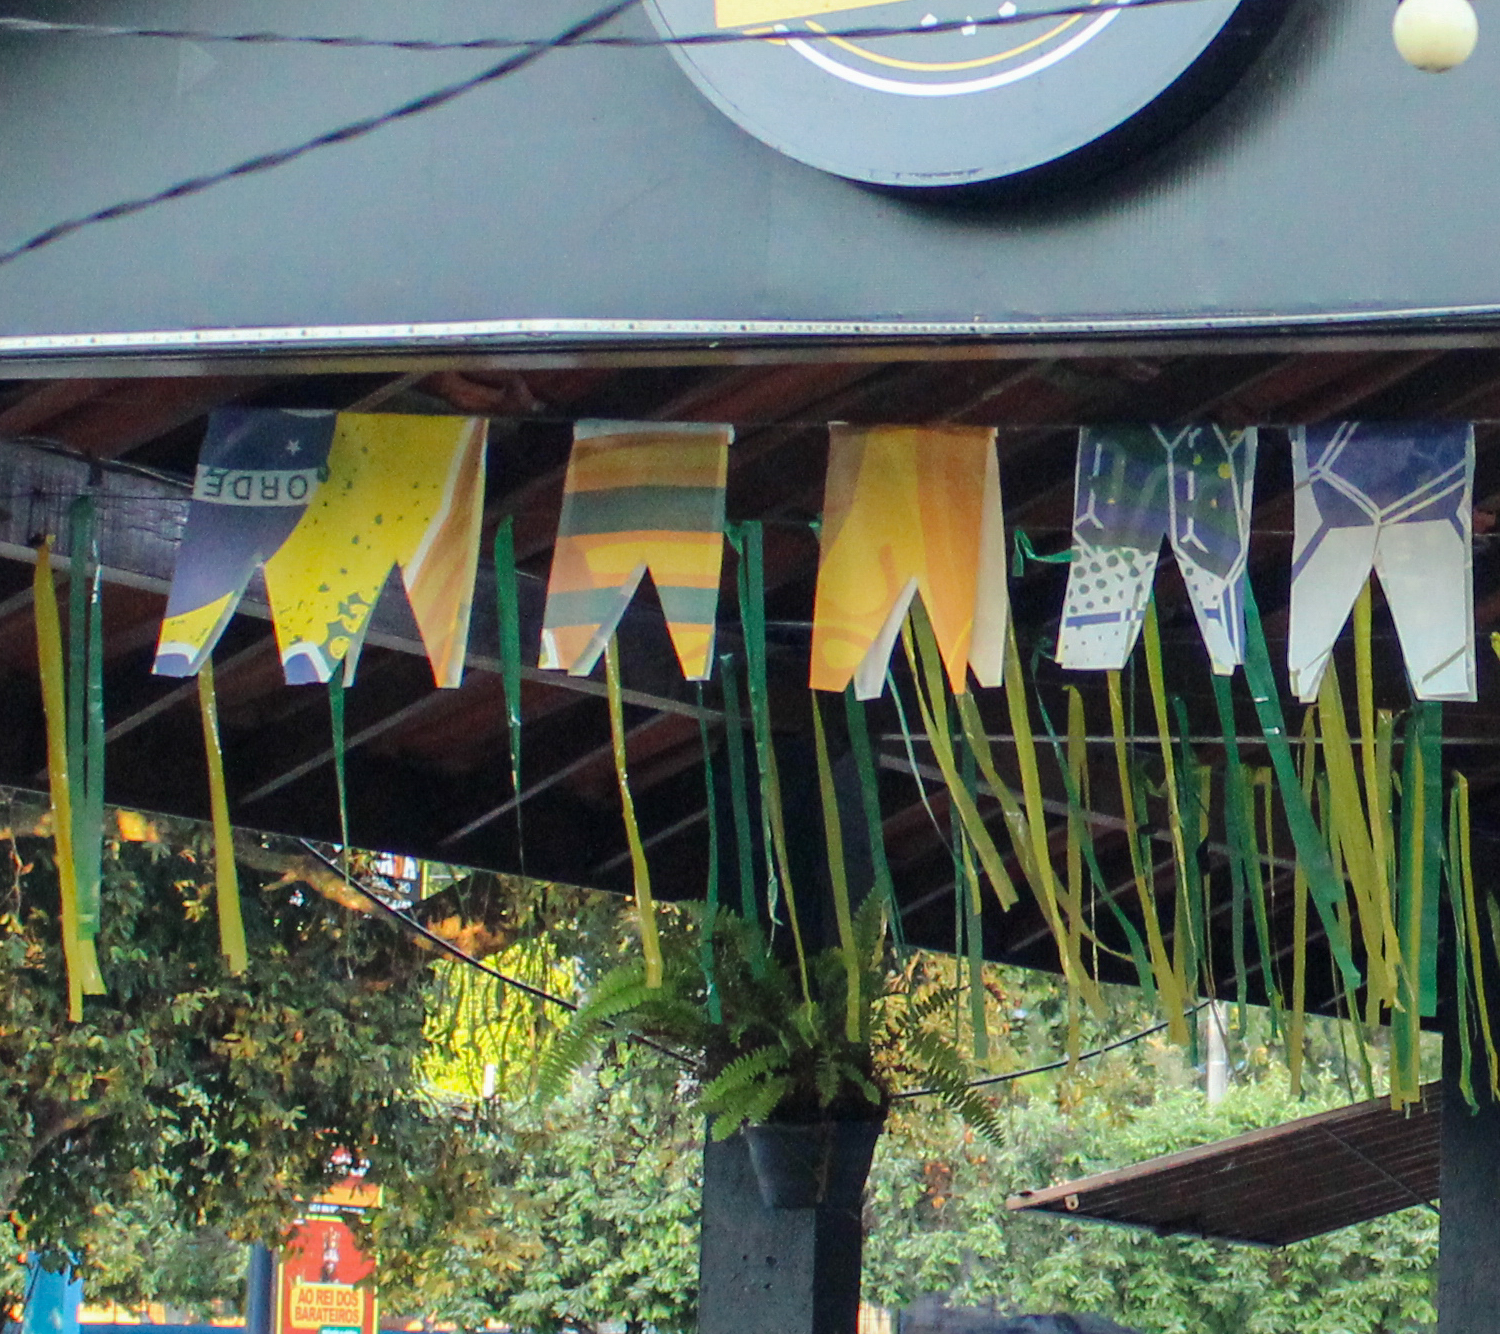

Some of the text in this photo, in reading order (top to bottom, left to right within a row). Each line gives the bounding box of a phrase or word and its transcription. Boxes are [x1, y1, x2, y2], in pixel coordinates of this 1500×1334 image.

[298, 1288, 359, 1307] AO REI DOS
[295, 1306, 359, 1323] BARATEIROS
